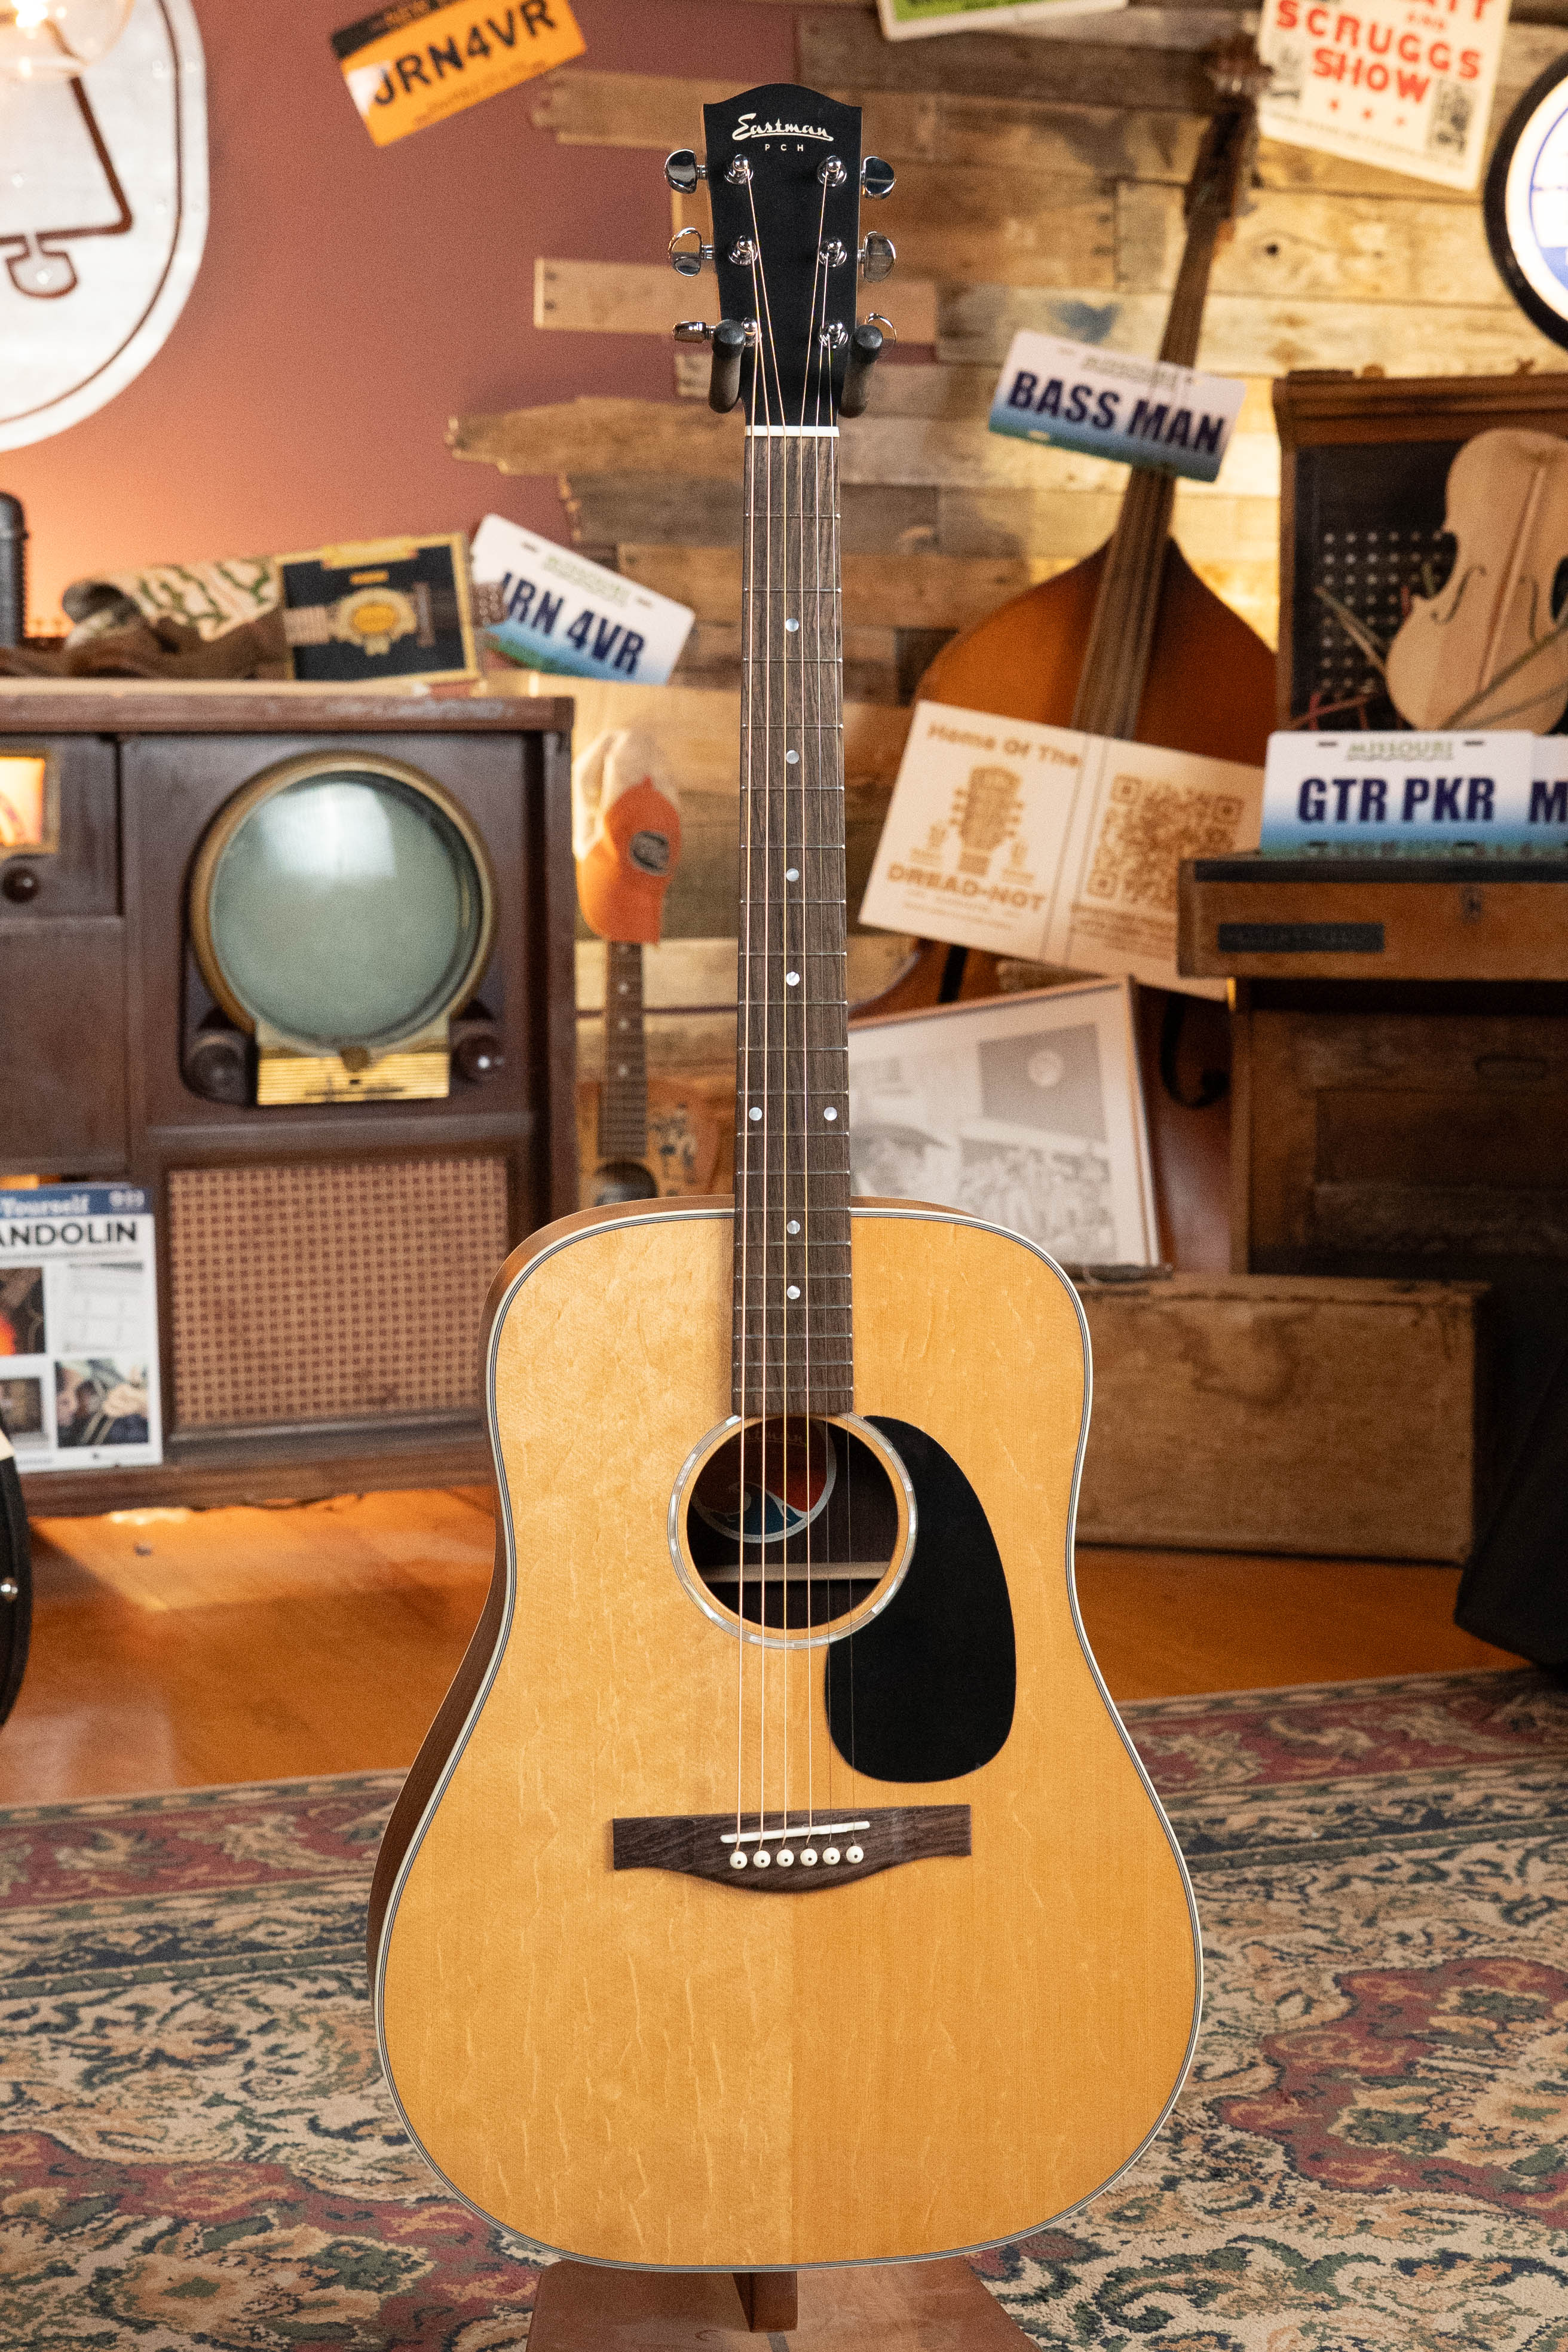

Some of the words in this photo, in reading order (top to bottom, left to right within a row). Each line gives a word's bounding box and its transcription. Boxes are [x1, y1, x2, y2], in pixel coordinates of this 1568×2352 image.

[374, 0, 556, 106] JRN4VR
[1275, 0, 1481, 79] SCRUGGS
[1313, 48, 1431, 103] SHOW
[732, 112, 834, 141] Eastman
[1006, 370, 1120, 430] BASS
[1127, 398, 1225, 454] MAN
[567, 609, 645, 675] 4VR
[926, 721, 997, 752] Home
[1298, 776, 1389, 823] GTR
[1401, 776, 1495, 822] PKR
[887, 861, 1046, 911] DREAD-NOT
[0, 1220, 136, 1246] NDOLIN
